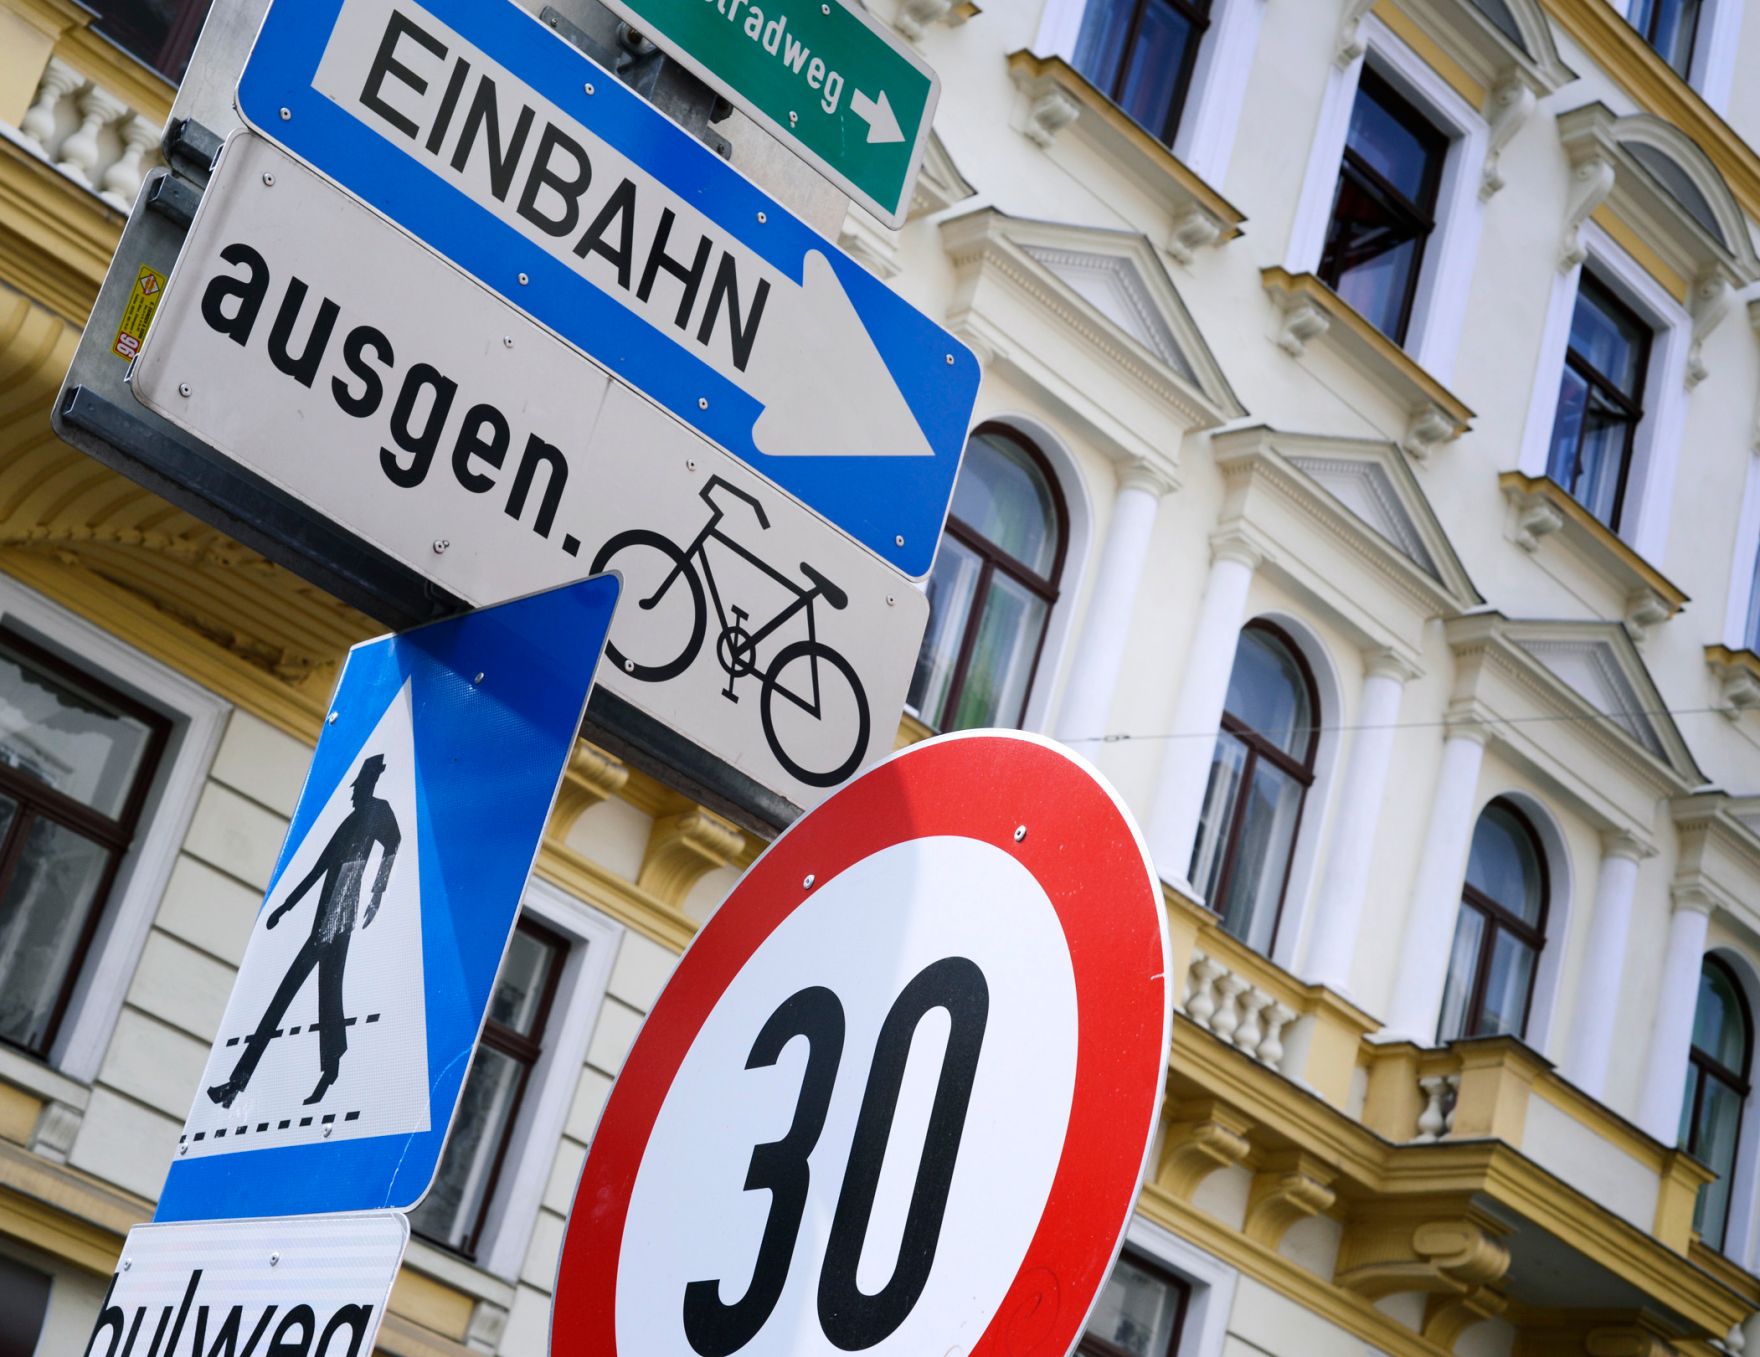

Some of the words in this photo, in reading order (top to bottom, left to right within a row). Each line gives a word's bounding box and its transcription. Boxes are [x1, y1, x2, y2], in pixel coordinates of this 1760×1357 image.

[117, 333, 138, 357] 96
[360, 10, 770, 372] EINBAHN
[202, 244, 580, 557] ausgen.
[683, 957, 989, 1357] 30
